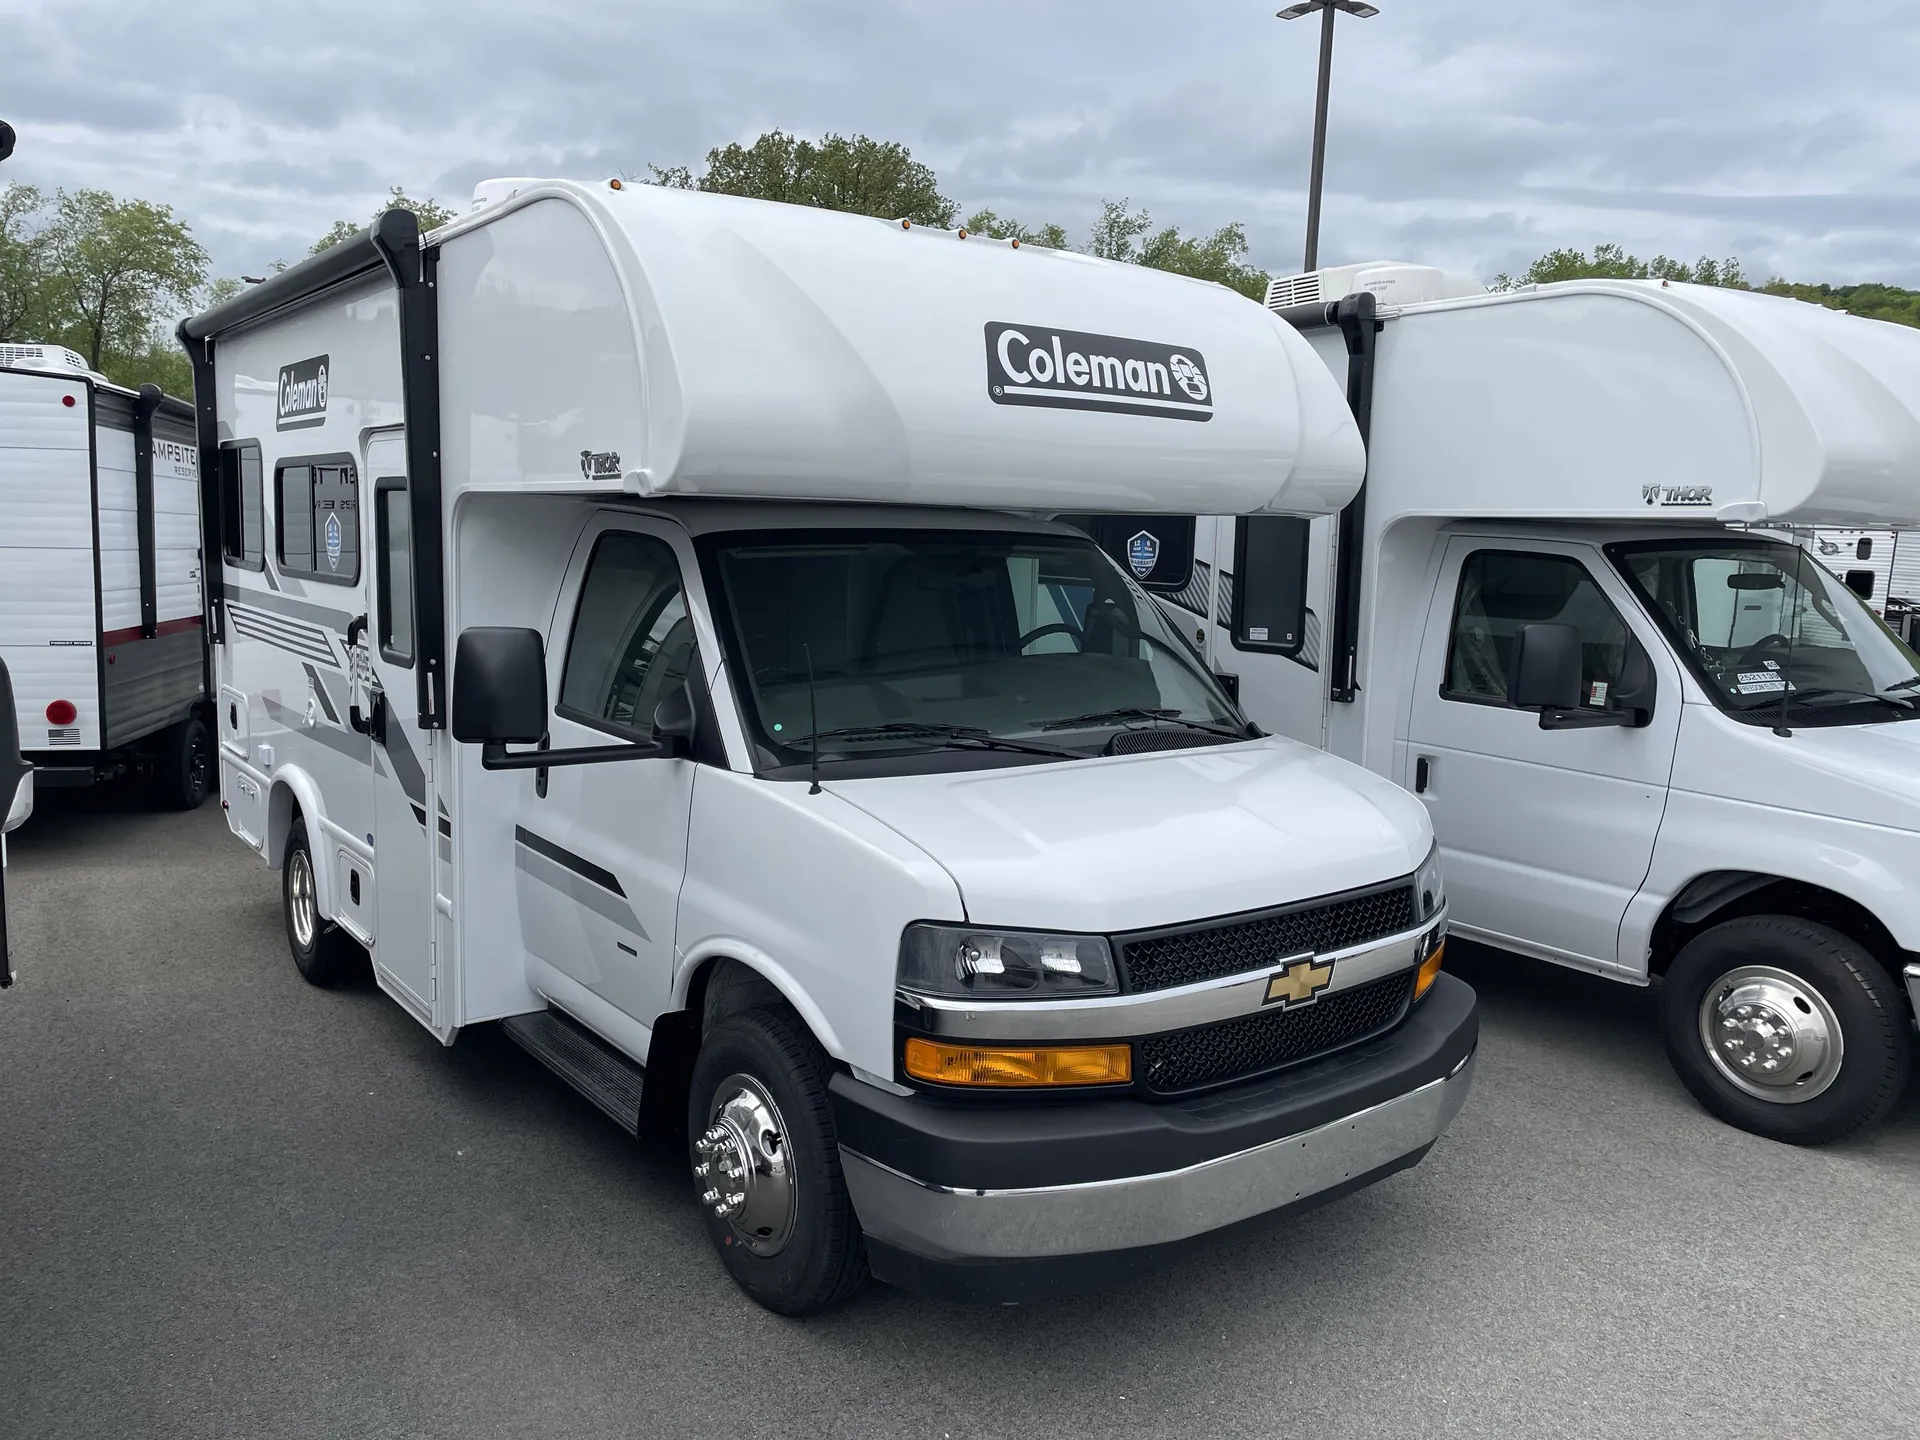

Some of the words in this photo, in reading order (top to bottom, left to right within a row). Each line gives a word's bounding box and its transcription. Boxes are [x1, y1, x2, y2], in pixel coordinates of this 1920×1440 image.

[997, 329, 1172, 395] Coleman
[280, 370, 318, 416] Coleman
[152, 440, 196, 465] AMPSITE
[591, 452, 621, 474] THOR
[1661, 485, 1713, 502] THOR
[1130, 558, 1155, 566] WARRANTY
[1739, 672, 1780, 682] 2521139
[1739, 683, 1764, 692] FREEDOM
